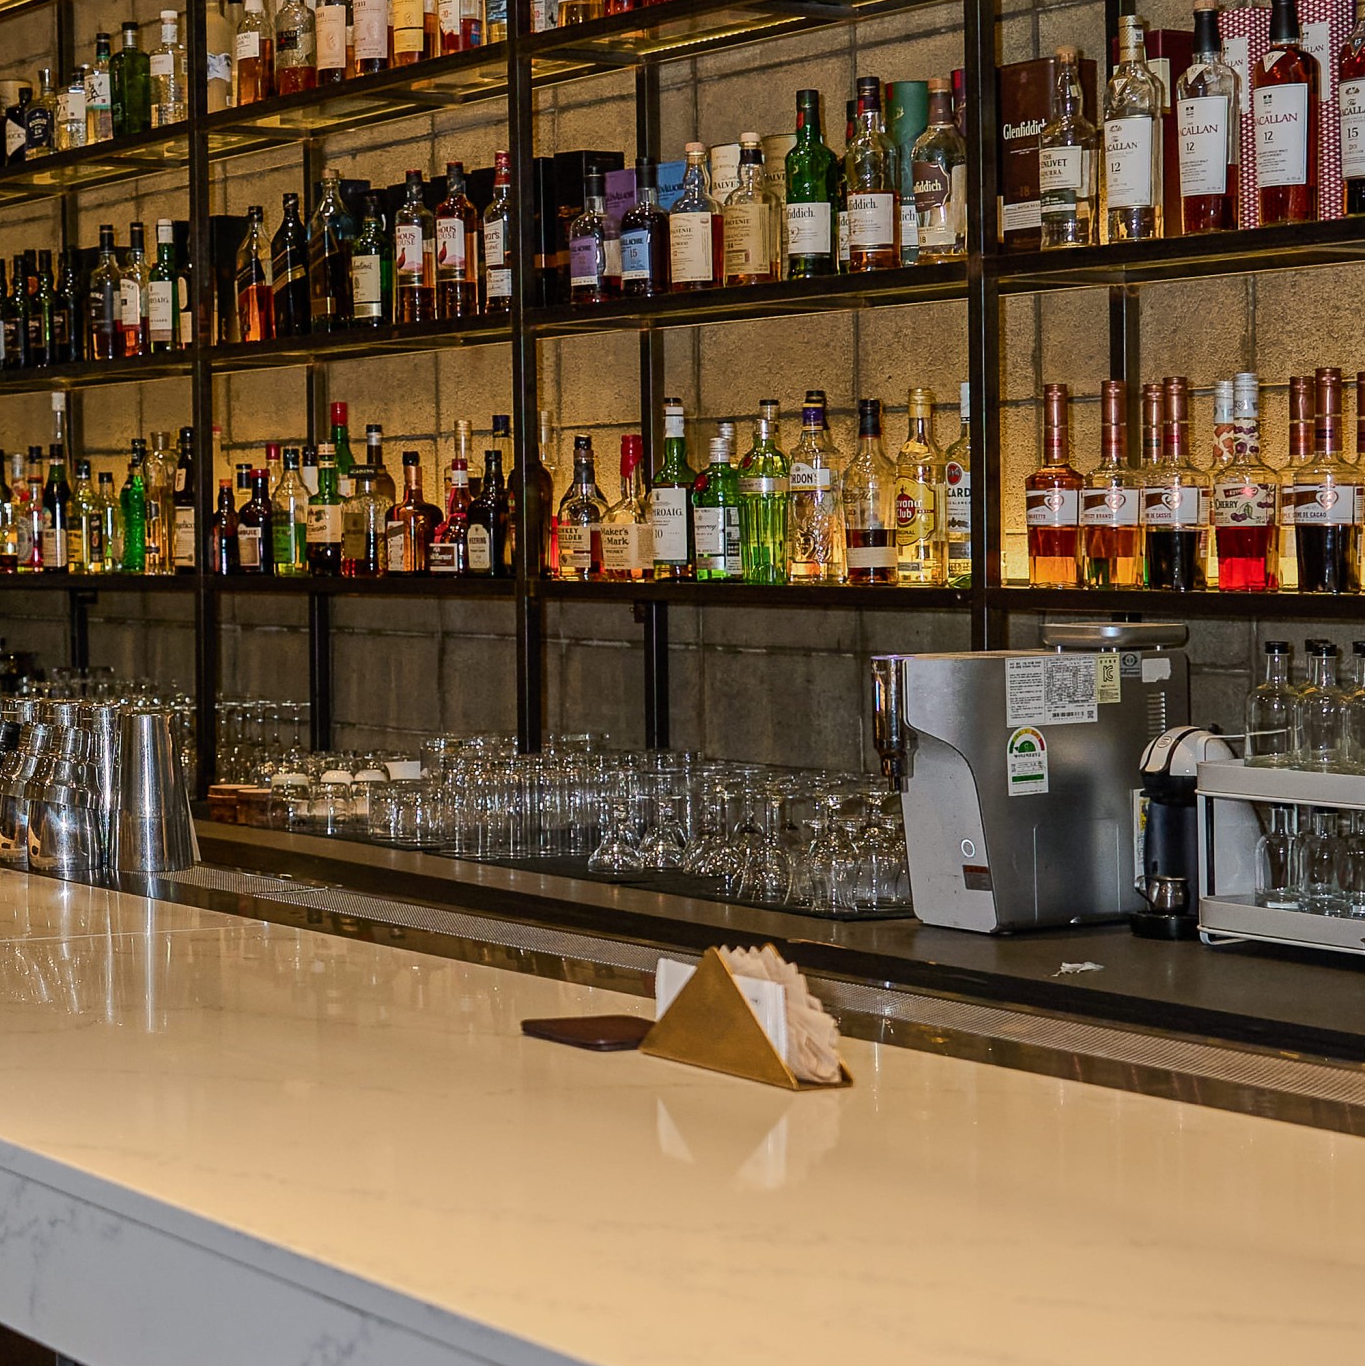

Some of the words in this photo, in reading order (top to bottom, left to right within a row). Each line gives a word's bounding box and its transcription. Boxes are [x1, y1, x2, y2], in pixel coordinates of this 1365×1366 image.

[1264, 130, 1274, 142] 12
[1347, 127, 1359, 139] 15
[1186, 141, 1195, 152] 12
[1110, 161, 1121, 173] 12
[919, 236, 927, 244] 18
[1215, 499, 1238, 510] CHERRY
[601, 527, 629, 536] Maker's
